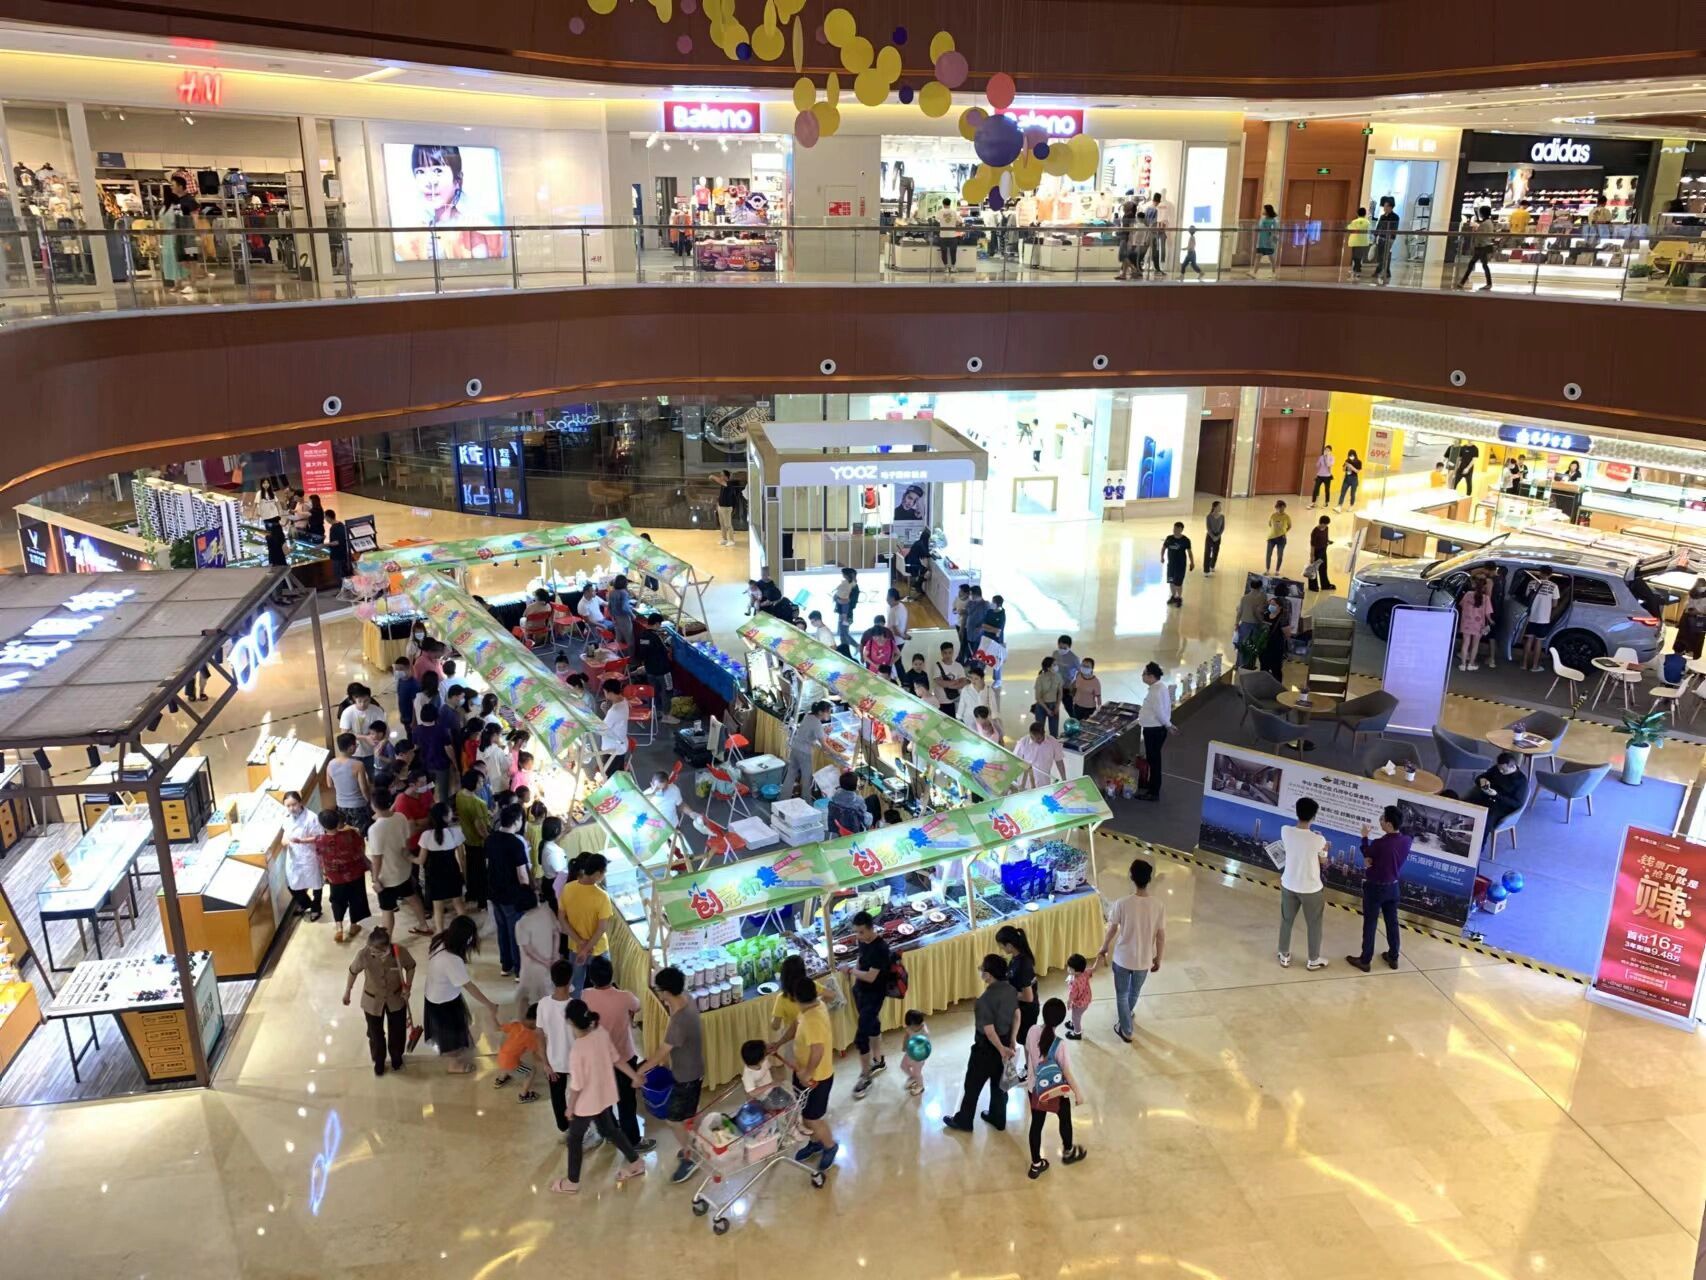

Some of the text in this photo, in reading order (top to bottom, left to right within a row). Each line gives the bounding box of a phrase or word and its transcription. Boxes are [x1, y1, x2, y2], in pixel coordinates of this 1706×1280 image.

[673, 103, 753, 130] Baleno
[1531, 138, 1591, 163] adidas
[830, 465, 878, 480] YOOZ
[1631, 878, 1688, 926] 赚
